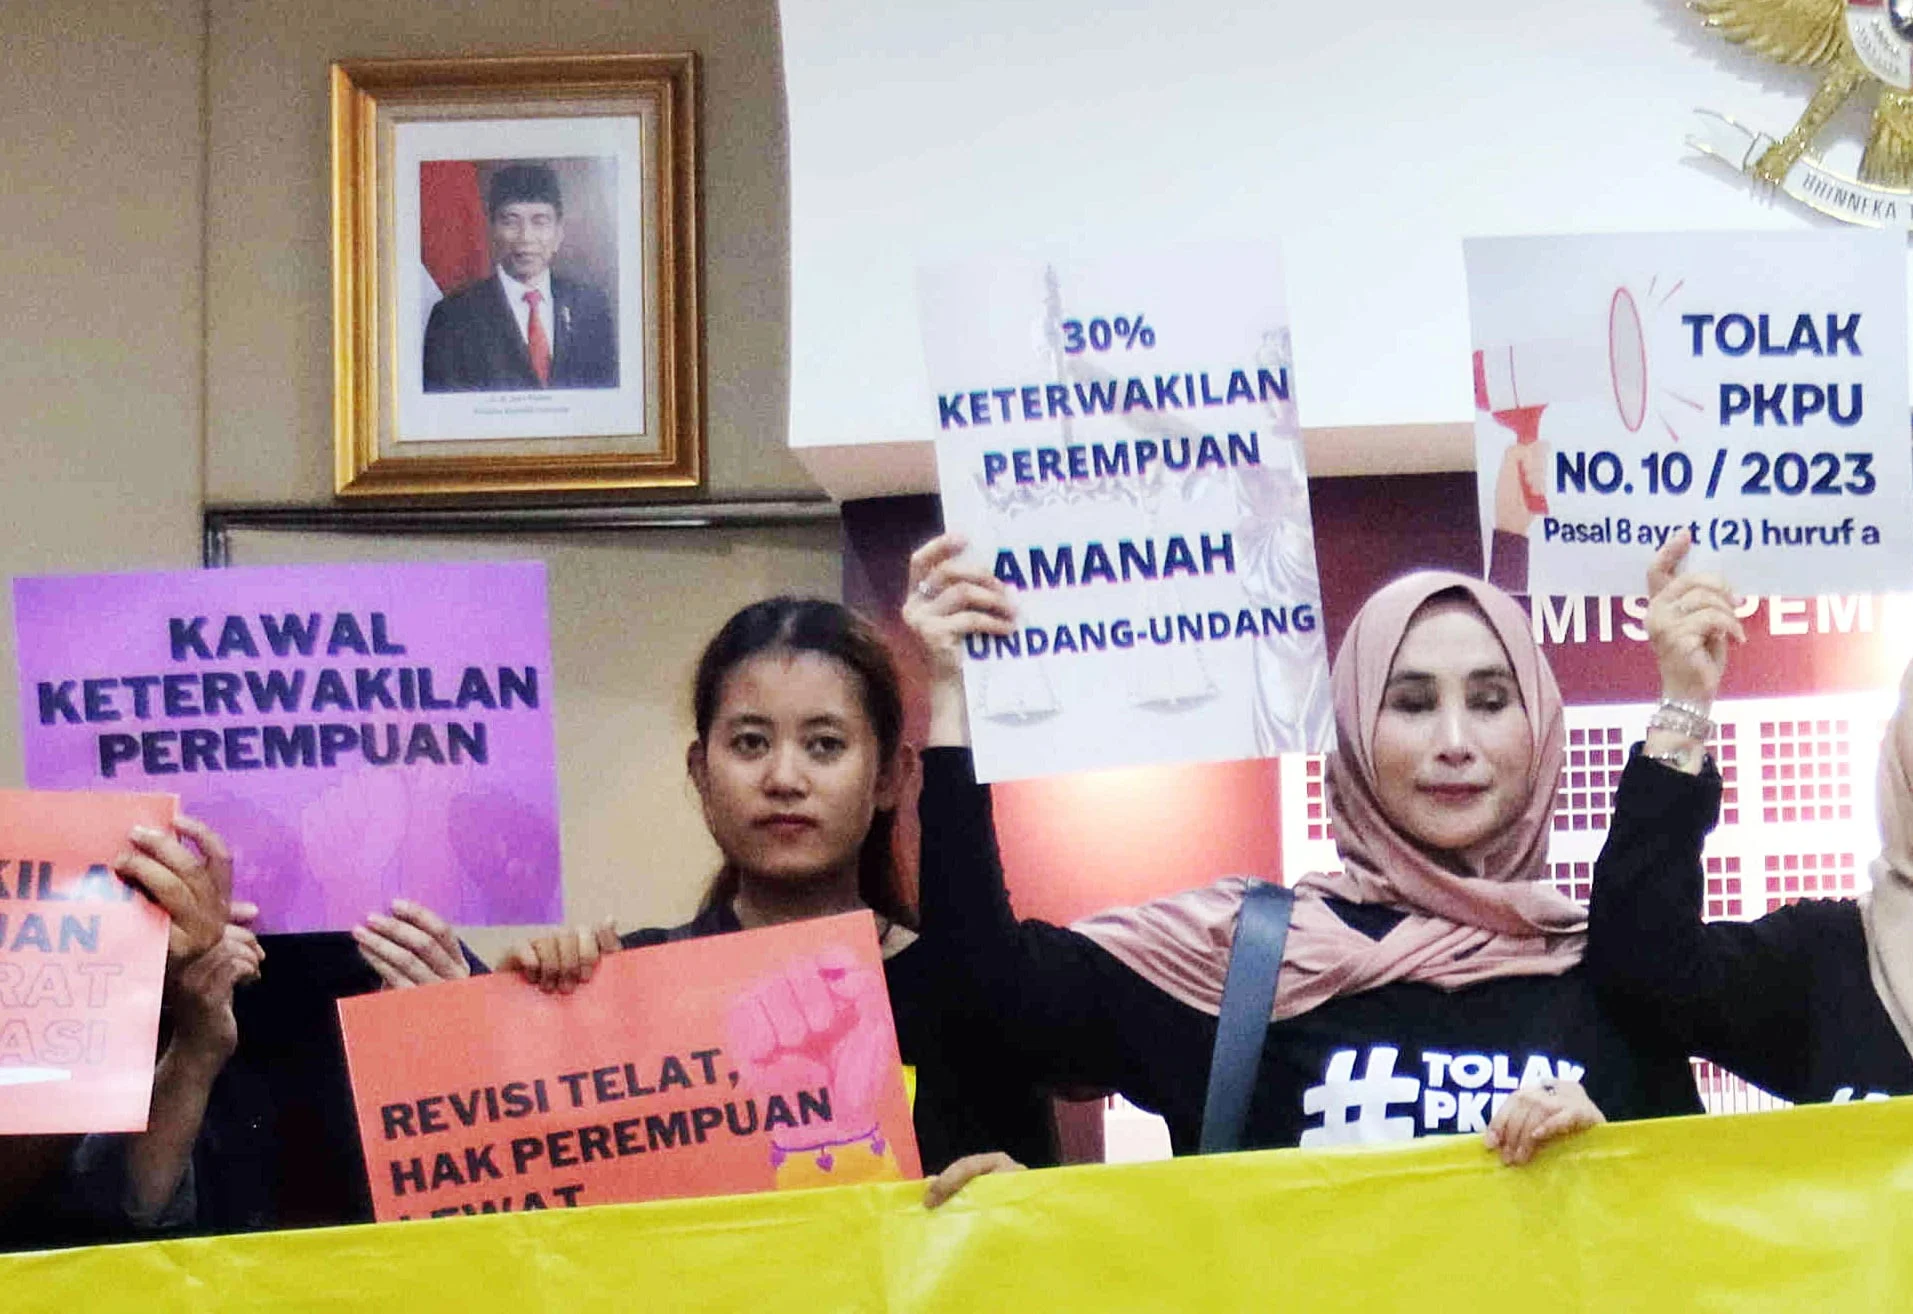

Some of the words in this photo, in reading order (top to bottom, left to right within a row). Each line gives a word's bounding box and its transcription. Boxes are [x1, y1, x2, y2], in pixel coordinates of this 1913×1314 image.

[1061, 314, 1156, 355] 30%
[1681, 313, 1863, 358] TOLAK
[938, 366, 1292, 431] KETERWAKILAN
[1719, 382, 1863, 428] PKPU
[983, 431, 1262, 487] PEREMPUAN
[1740, 451, 1877, 496] 2023
[993, 531, 1238, 592] AMANAH
[1543, 517, 1612, 544] Pasal
[1616, 518, 1632, 545] 8
[1637, 521, 1701, 550] ayt
[1708, 519, 1753, 550] (2)
[1761, 518, 1855, 546] huruf
[1861, 526, 1881, 545] a
[168, 611, 407, 662] KAWAL
[964, 604, 1317, 662] UNDANG-UNDANG
[36, 665, 541, 728] KETERWAKILAN
[97, 721, 489, 779] PEREMPUAN
[380, 1079, 545, 1141] REVISI
[558, 1047, 740, 1108] TELAT,
[390, 1139, 501, 1197] HAK
[511, 1087, 834, 1175] PEREMPUAN
